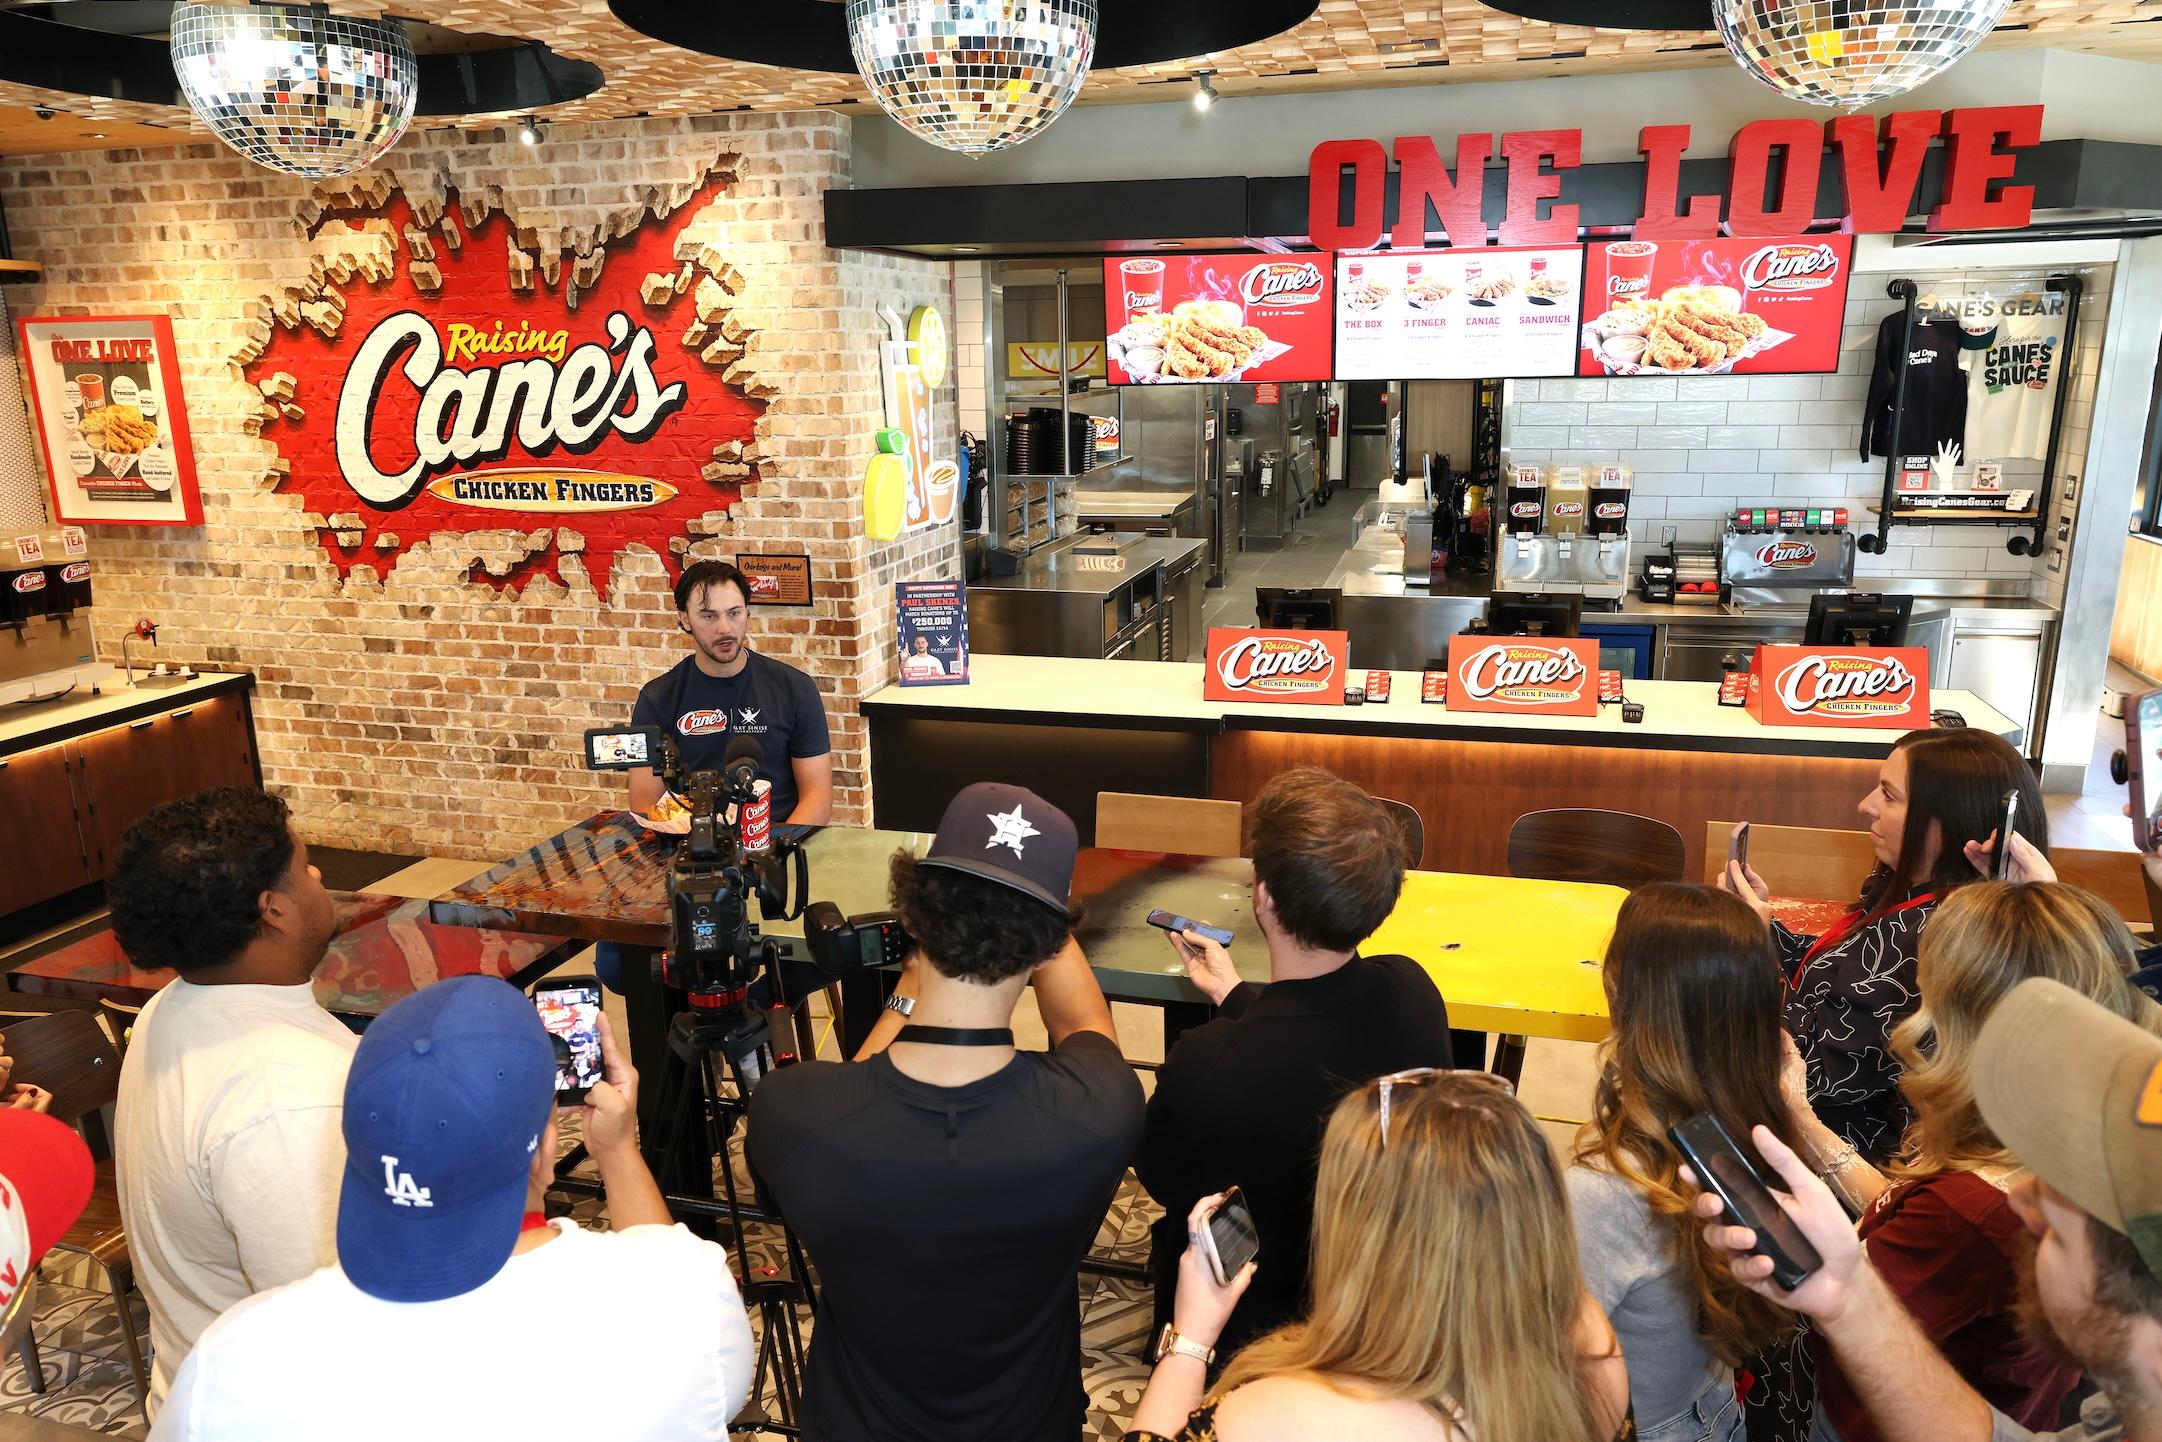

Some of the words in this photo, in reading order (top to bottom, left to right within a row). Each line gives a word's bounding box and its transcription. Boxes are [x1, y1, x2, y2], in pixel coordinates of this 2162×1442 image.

[1309, 129, 1582, 250] ONE
[1635, 104, 2044, 240] LOVE
[1745, 244, 1837, 289] Cane's
[1244, 262, 1322, 304] Cane's
[2001, 299, 2065, 317] GEAR
[1365, 320, 1382, 328] BOX
[1412, 319, 1446, 327] FINGER
[1466, 317, 1500, 325] CANIAC
[1519, 315, 1570, 324] SANDWICH
[447, 320, 570, 361] Raising
[51, 340, 93, 363] ONE
[97, 340, 155, 363] LOVE
[1984, 365, 2047, 387] SAUCE
[335, 310, 688, 512] Cane's
[1520, 472, 1536, 482] TEA
[1603, 472, 1620, 481] TEA
[454, 479, 549, 501] CHICKEN
[557, 479, 654, 503] FINGERS
[19, 543, 40, 555] TEA
[64, 535, 84, 547] TEA
[1758, 541, 1816, 567] Cane's
[925, 598, 960, 606] SKENES
[1263, 641, 1301, 652] Raising
[1509, 649, 1549, 660] Raising
[1224, 637, 1333, 688] Cane's
[1466, 645, 1584, 698] Cane's
[1829, 660, 1873, 672] Raising
[1783, 657, 1913, 712] Cane's
[1504, 689, 1536, 697] CHICKEN
[1538, 690, 1570, 699] FINGERS
[1826, 702, 1861, 711] CHICKEN
[1864, 702, 1900, 712] FINGERS
[680, 708, 727, 735] Cane's
[381, 1155, 433, 1207] LA
